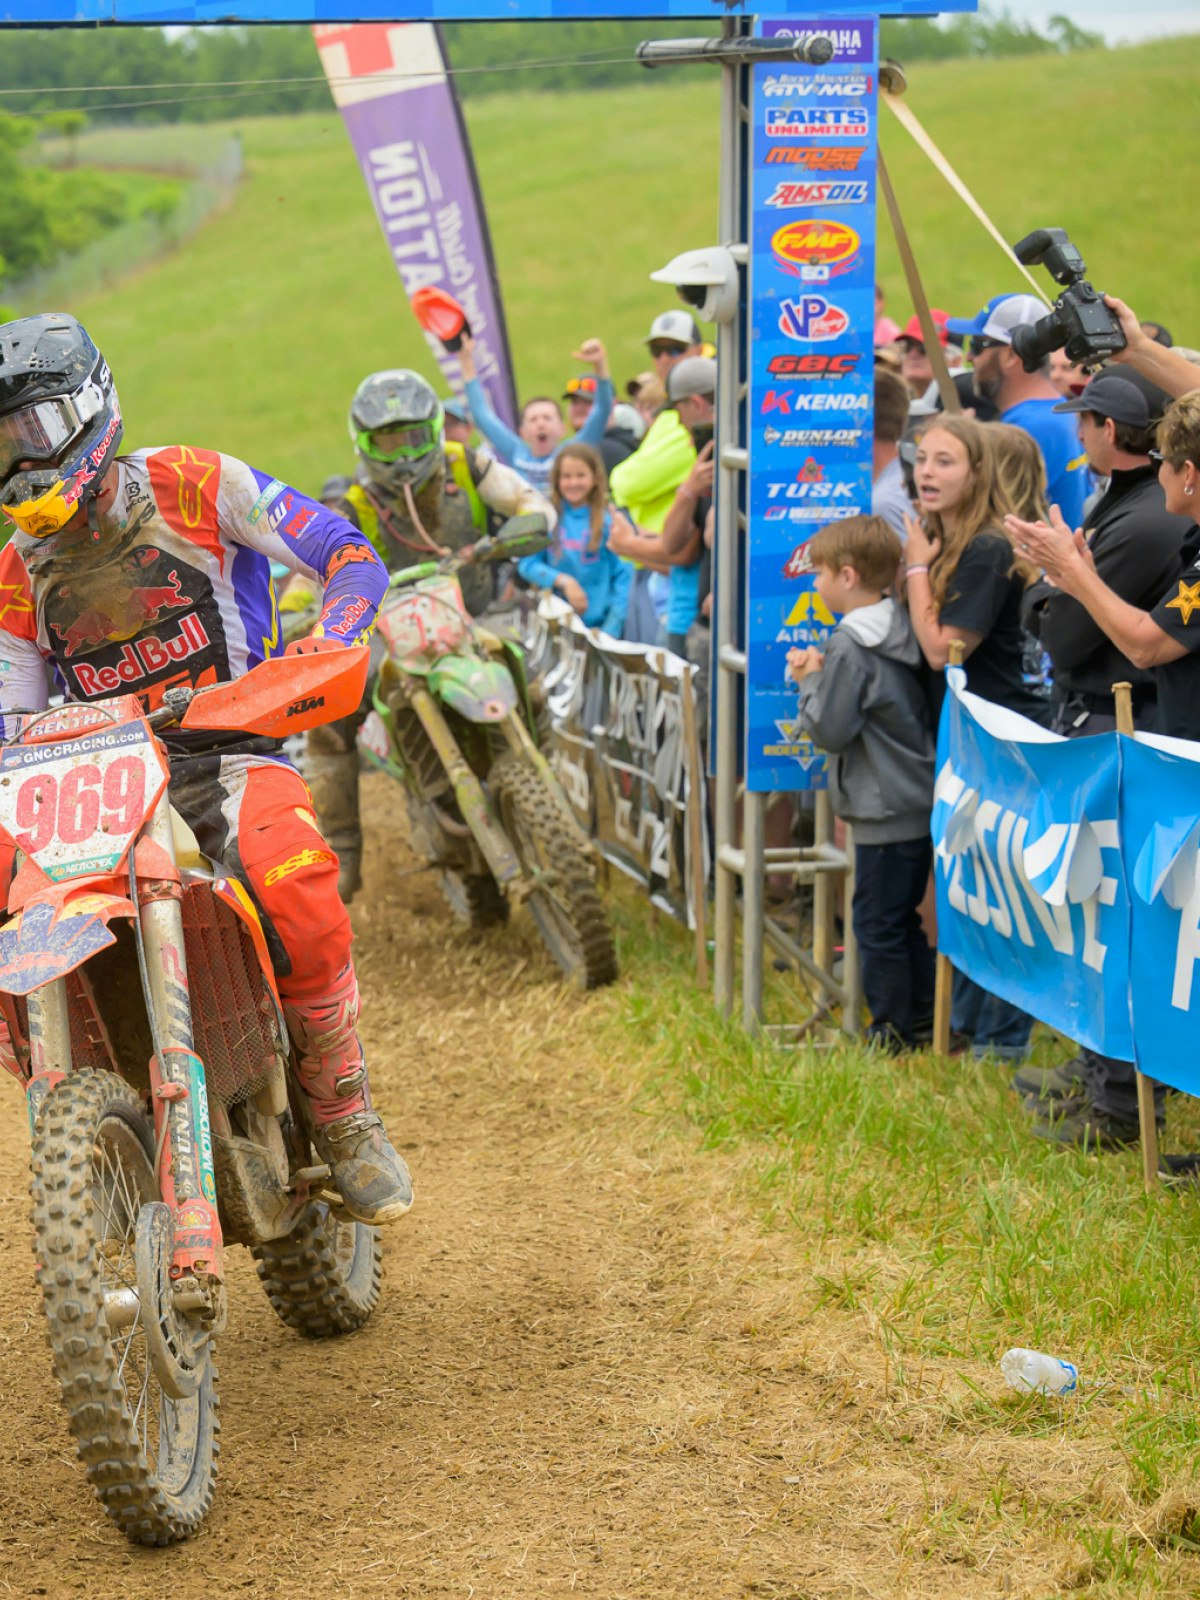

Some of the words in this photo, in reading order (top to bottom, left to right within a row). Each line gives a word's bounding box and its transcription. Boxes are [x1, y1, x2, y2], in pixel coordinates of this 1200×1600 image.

[767, 109, 867, 124] PARTS
[767, 125, 867, 136] UNLIMITED
[765, 147, 867, 163] MOOSE
[771, 183, 865, 205] AMSOIL
[779, 231, 852, 249] FMF
[783, 298, 827, 338] VP
[767, 354, 860, 373] GBC
[795, 393, 869, 411] KENDA
[780, 429, 862, 442] DUNLOP
[766, 482, 857, 498] TUSK
[775, 628, 831, 643] ARM
[72, 643, 146, 697] Red
[135, 612, 211, 675] Bull
[287, 695, 325, 717] KTM
[30, 709, 122, 738] RENTHAL
[23, 731, 145, 764] GNCCRACING.COM
[15, 755, 147, 854] 969
[170, 1063, 195, 1177] DUNLP
[197, 1082, 215, 1172] MOTOREX
